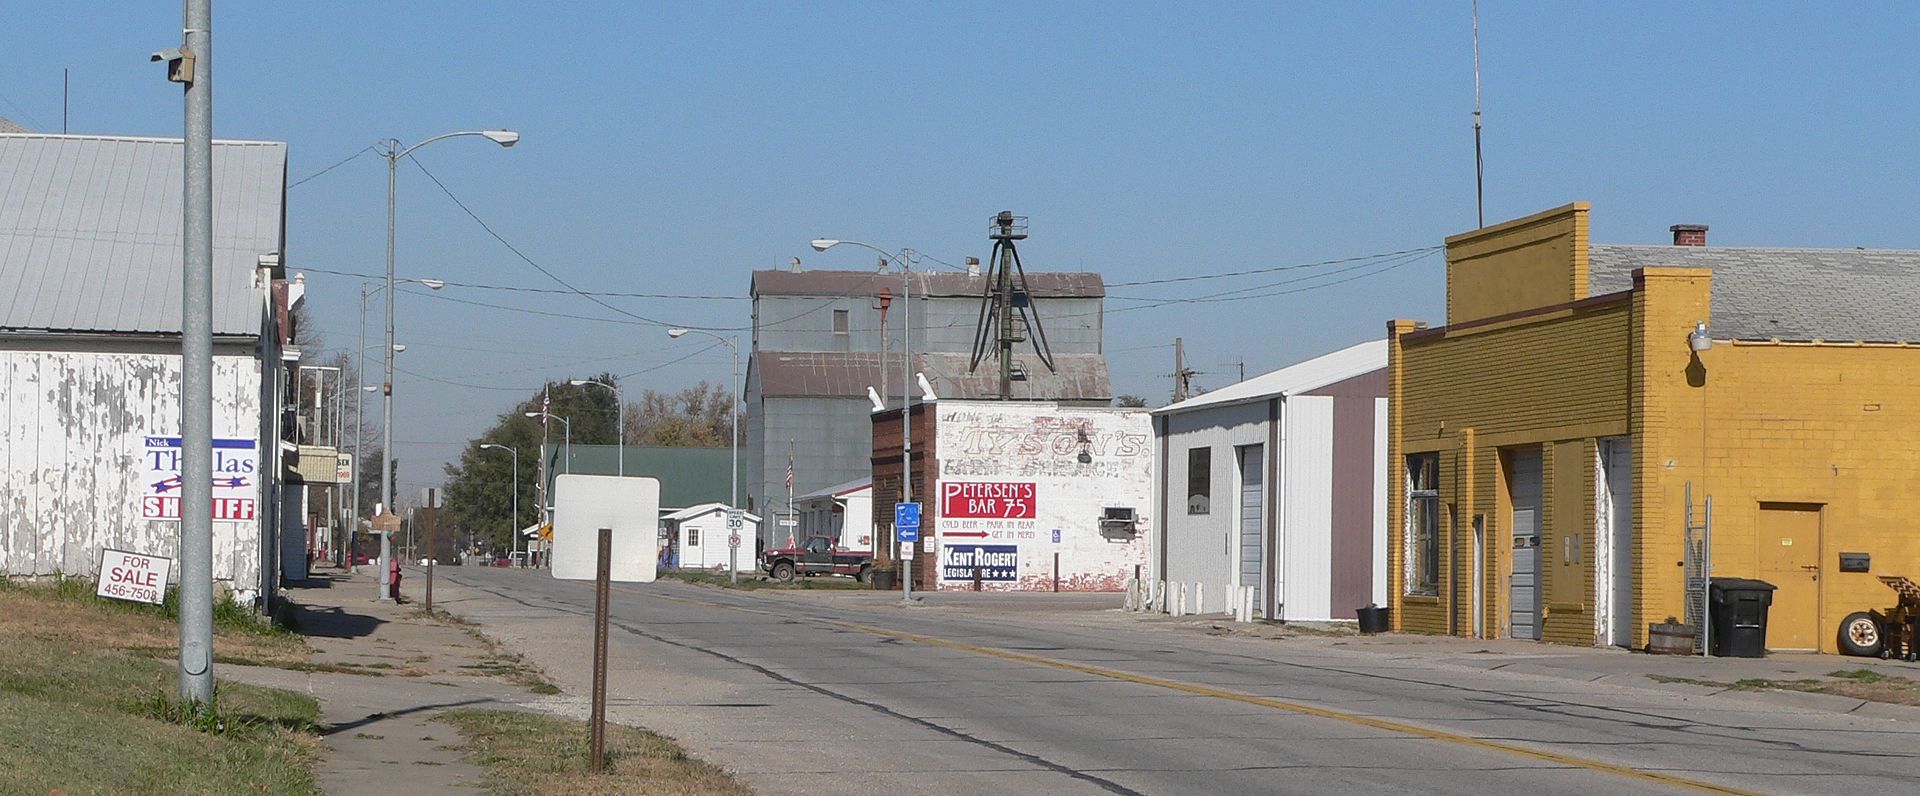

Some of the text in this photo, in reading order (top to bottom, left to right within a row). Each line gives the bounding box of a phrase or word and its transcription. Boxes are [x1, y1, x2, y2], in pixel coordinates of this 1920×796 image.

[148, 439, 169, 447] Nick
[945, 483, 1033, 515] PETERSEN'S
[144, 497, 253, 519] SHIFF
[968, 499, 1027, 518] BAR 75
[728, 519, 742, 528] 30
[942, 520, 959, 528] COLD
[962, 520, 978, 528] BEER
[1017, 521, 1035, 529] REAR
[991, 530, 1003, 539] GET
[1006, 531, 1015, 539] IN
[122, 555, 150, 570] FOR
[944, 547, 1017, 567] KENT ROGERT
[110, 567, 159, 588] SALE
[943, 568, 991, 578] LEGISLARE
[104, 584, 158, 602] 456-7508
